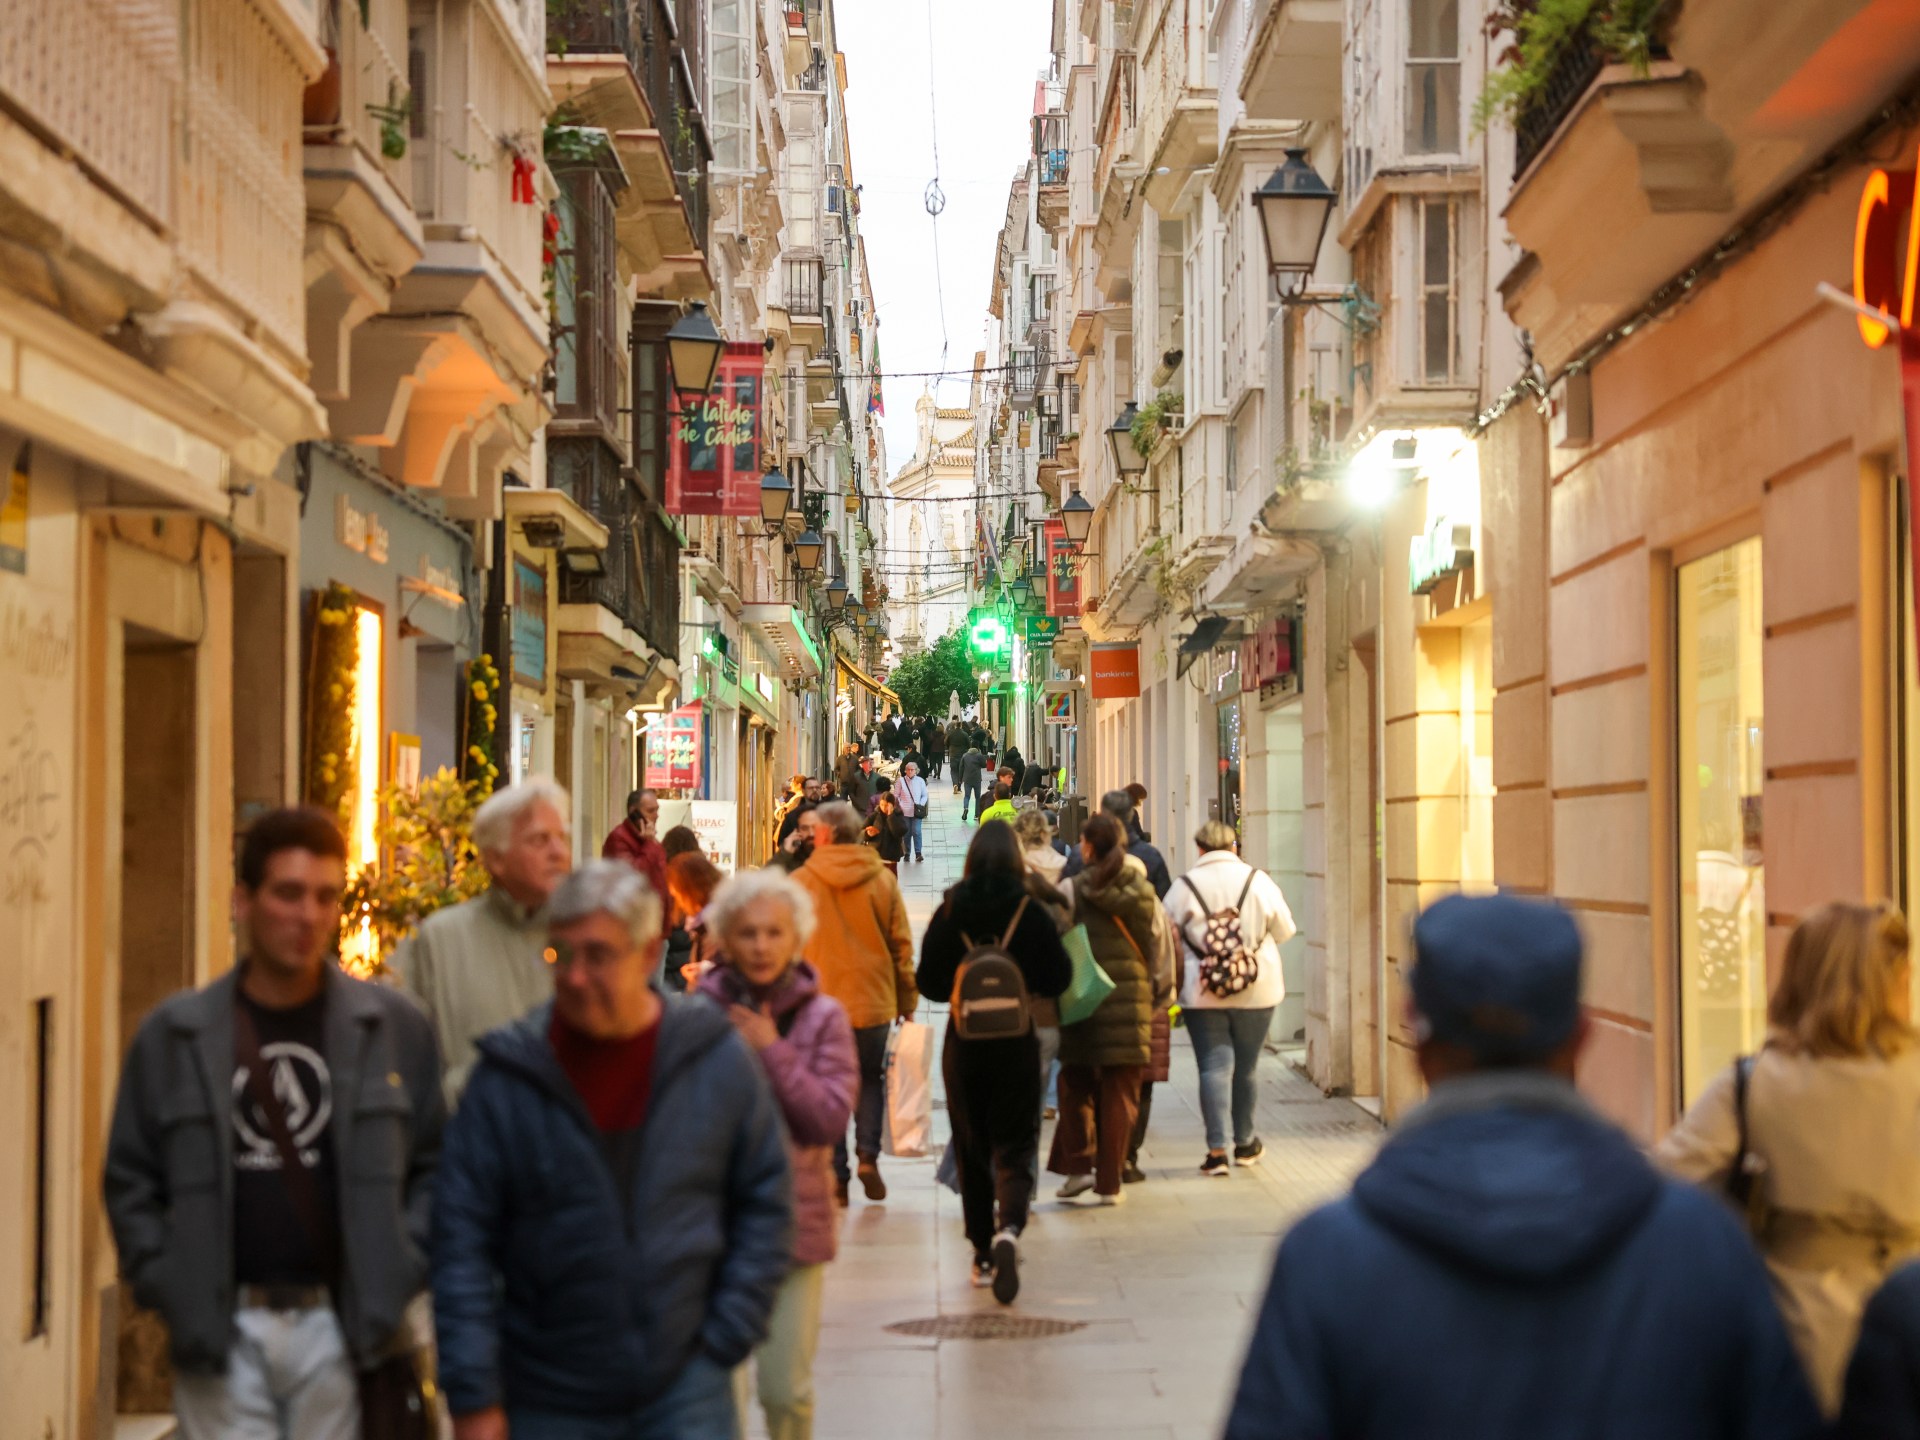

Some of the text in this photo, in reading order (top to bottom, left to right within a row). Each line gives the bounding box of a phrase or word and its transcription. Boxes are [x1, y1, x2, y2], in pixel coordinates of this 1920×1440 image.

[702, 397, 753, 425] latido
[677, 423, 701, 443] de
[1050, 566, 1064, 577] de
